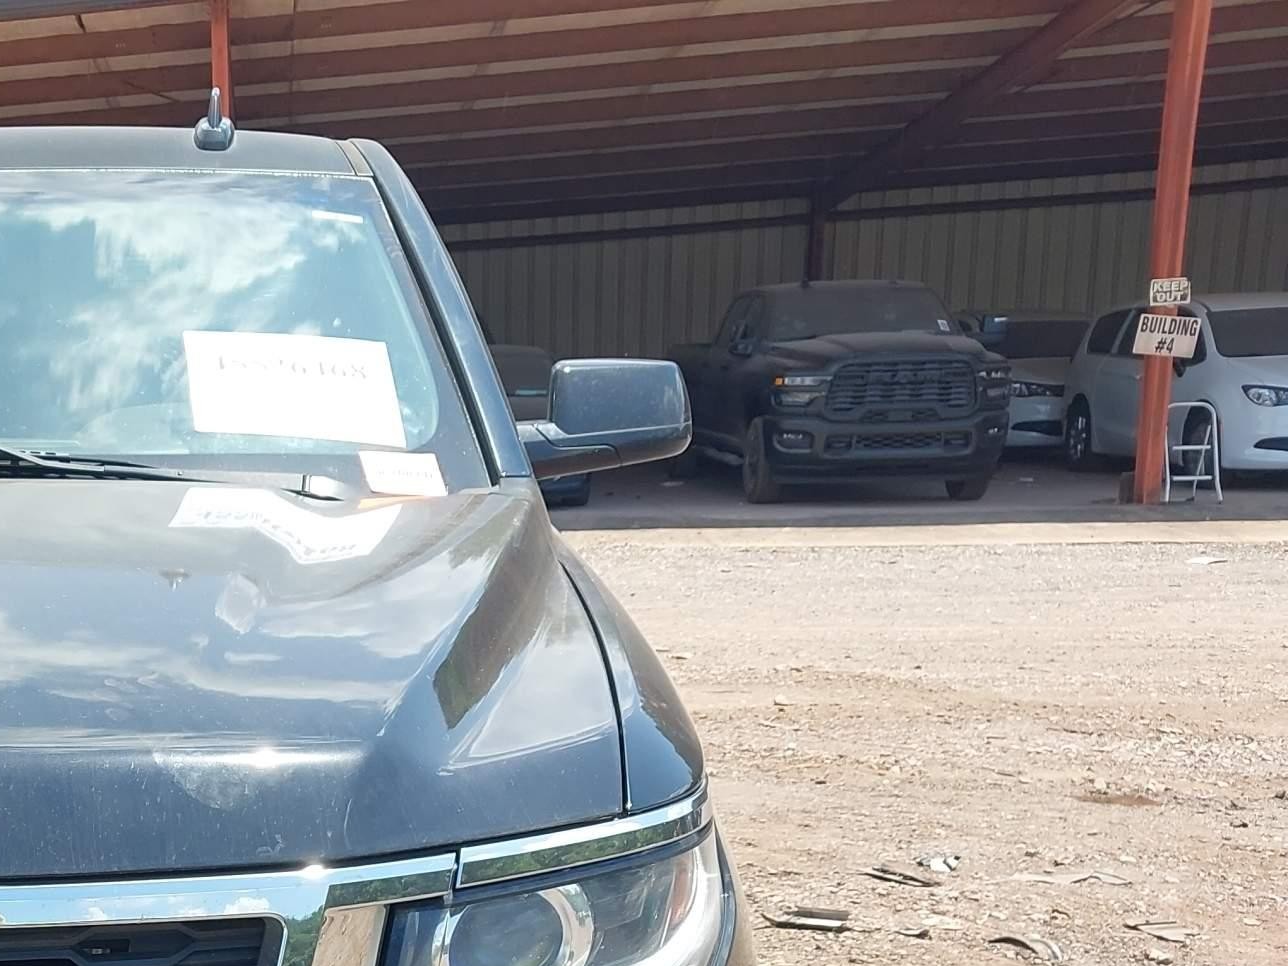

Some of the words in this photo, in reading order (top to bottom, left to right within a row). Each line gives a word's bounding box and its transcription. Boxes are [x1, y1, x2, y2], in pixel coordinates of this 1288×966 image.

[1153, 280, 1188, 292] KEEP
[1156, 292, 1184, 302] OUT
[1140, 316, 1199, 336] BUILDING
[1155, 337, 1175, 353] #4
